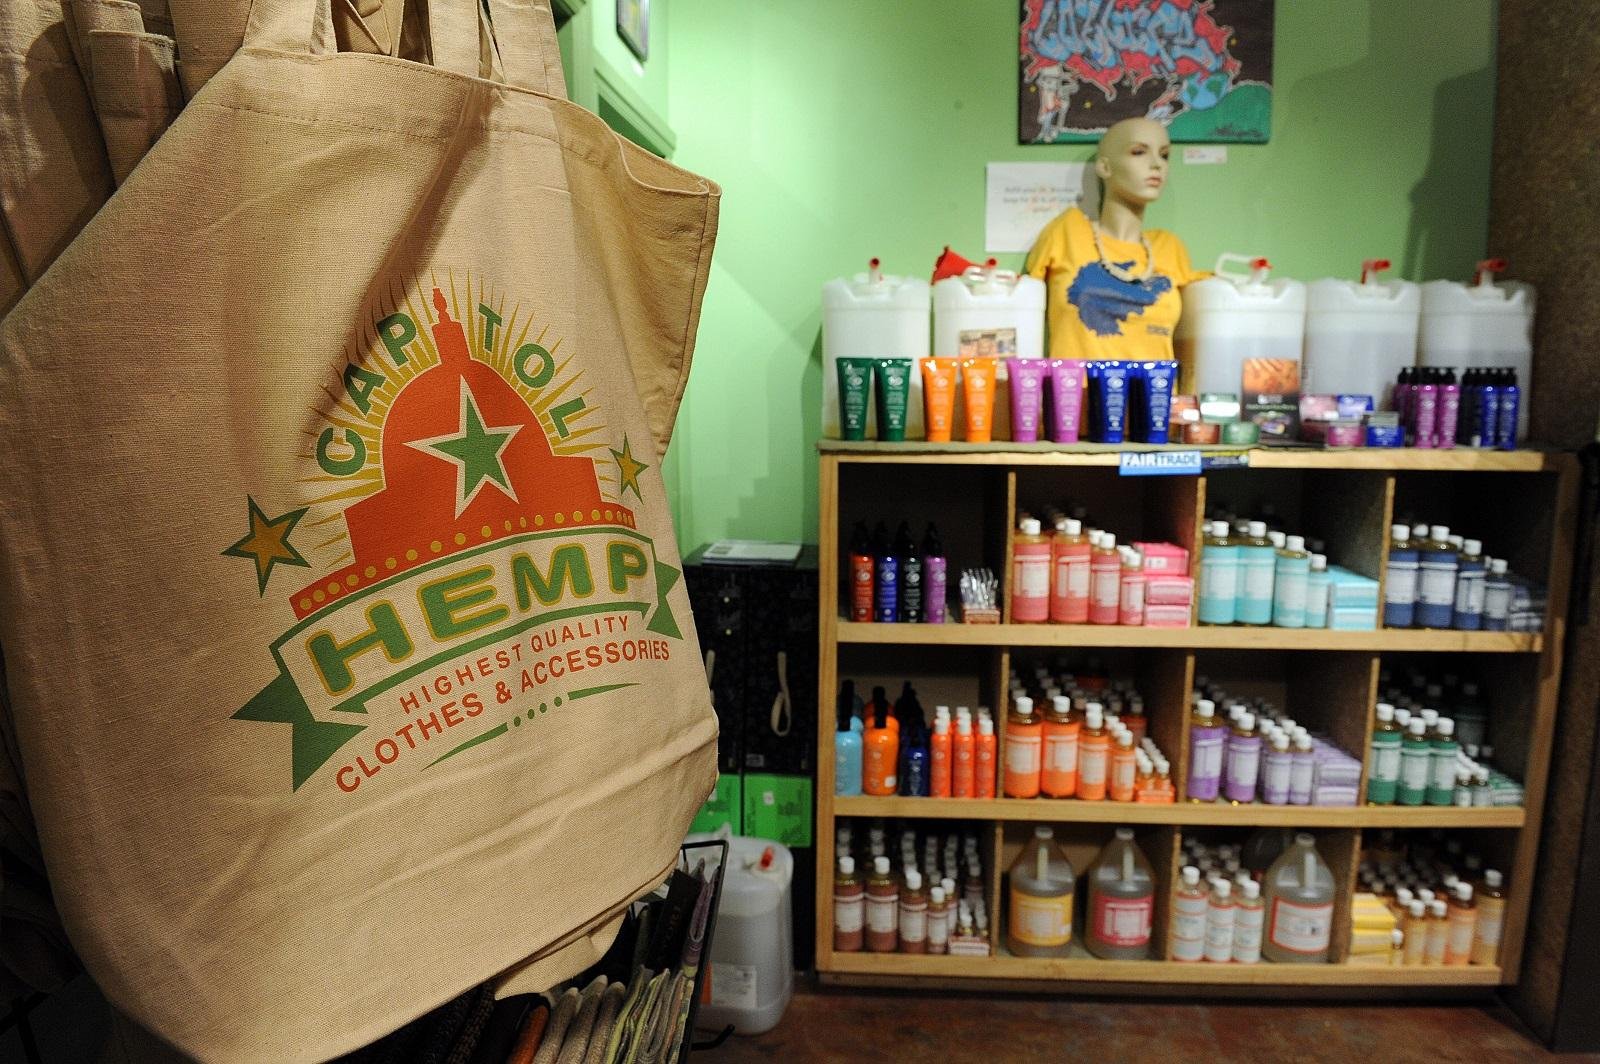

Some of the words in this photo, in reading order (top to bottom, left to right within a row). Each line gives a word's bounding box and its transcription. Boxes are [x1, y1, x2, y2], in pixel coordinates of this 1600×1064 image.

[305, 541, 649, 697] HEMP
[400, 643, 522, 713] HIGHEST
[531, 615, 629, 653] QUALITY
[336, 696, 484, 792] CLOTHES
[496, 682, 512, 705] &
[520, 640, 670, 692] ACCESSORIES
